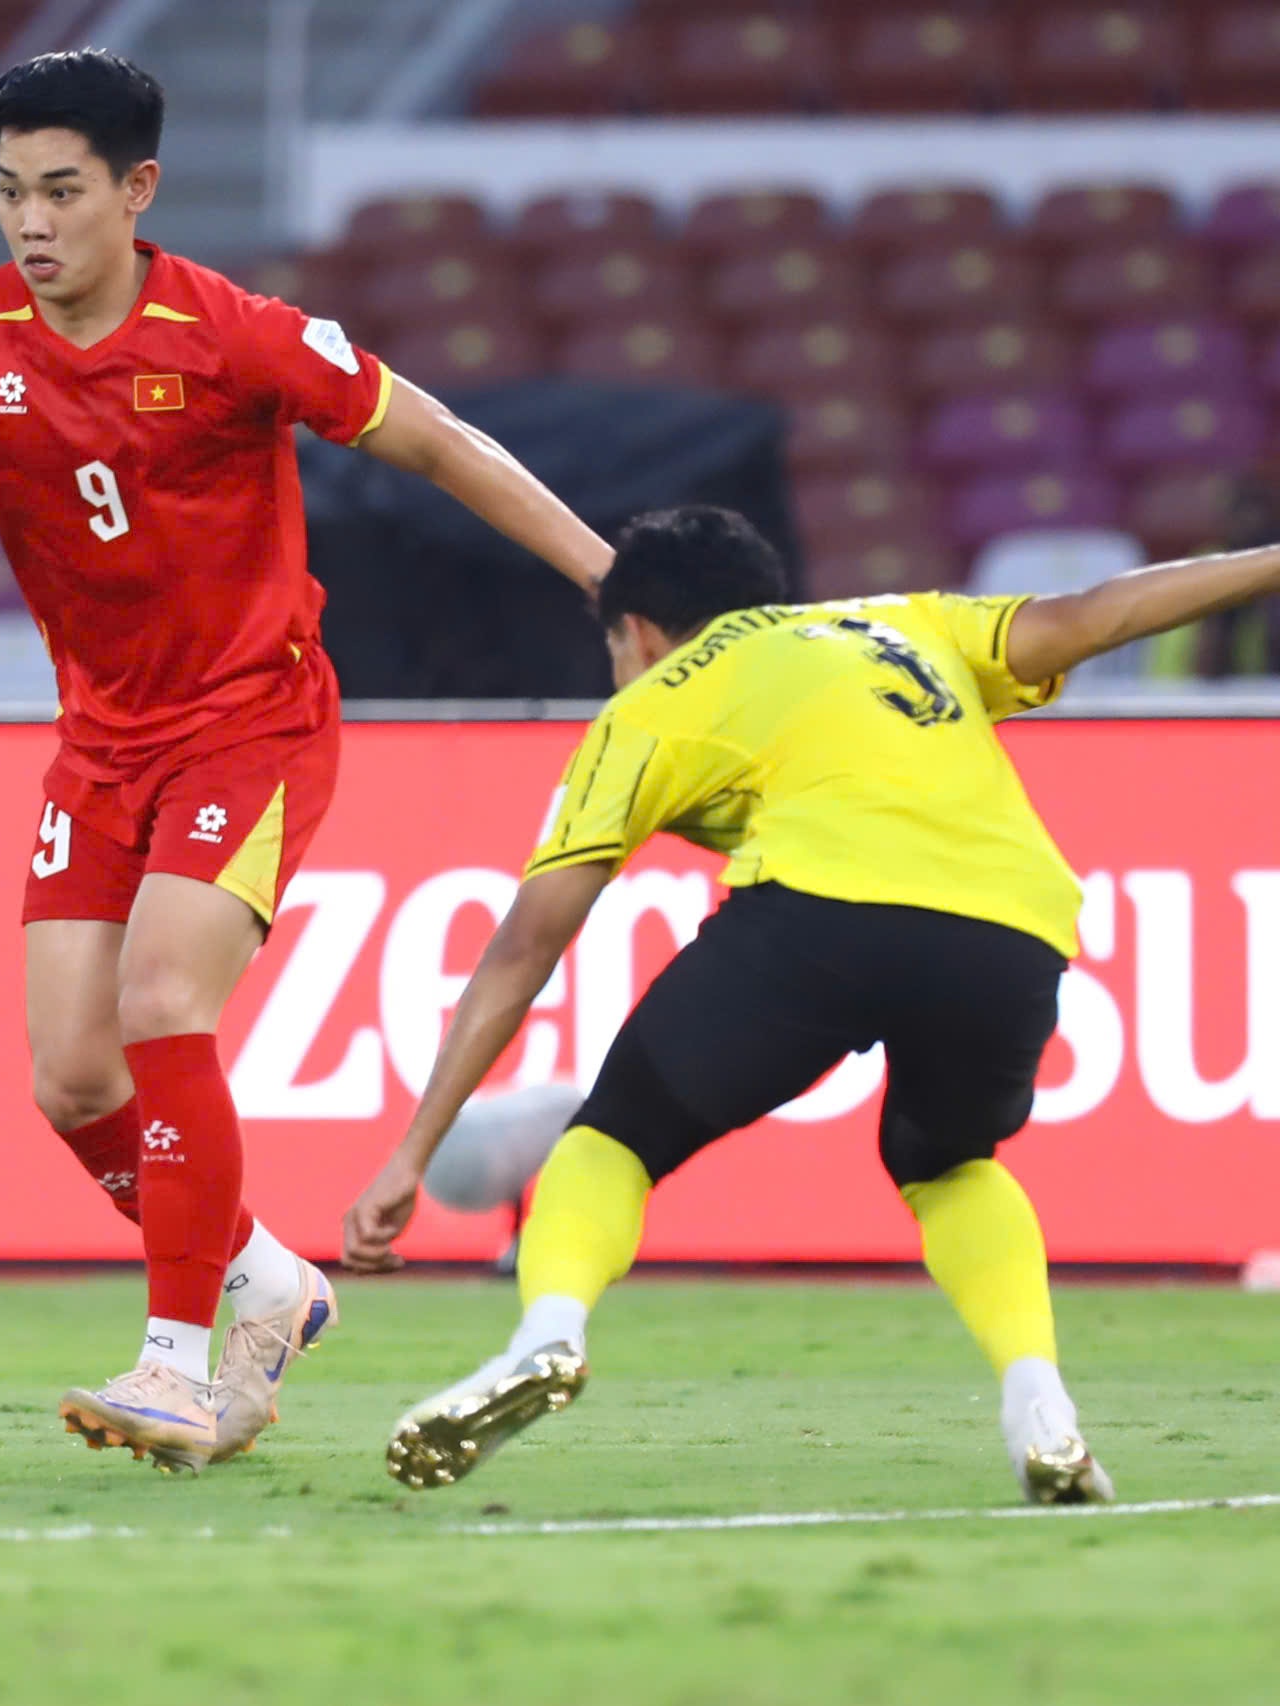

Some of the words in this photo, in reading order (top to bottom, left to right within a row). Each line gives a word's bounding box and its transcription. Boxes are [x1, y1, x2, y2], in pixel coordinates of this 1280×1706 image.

[75, 460, 130, 542] 9
[794, 615, 963, 727] 3
[31, 800, 72, 880] 9
[228, 866, 886, 1122] zer
